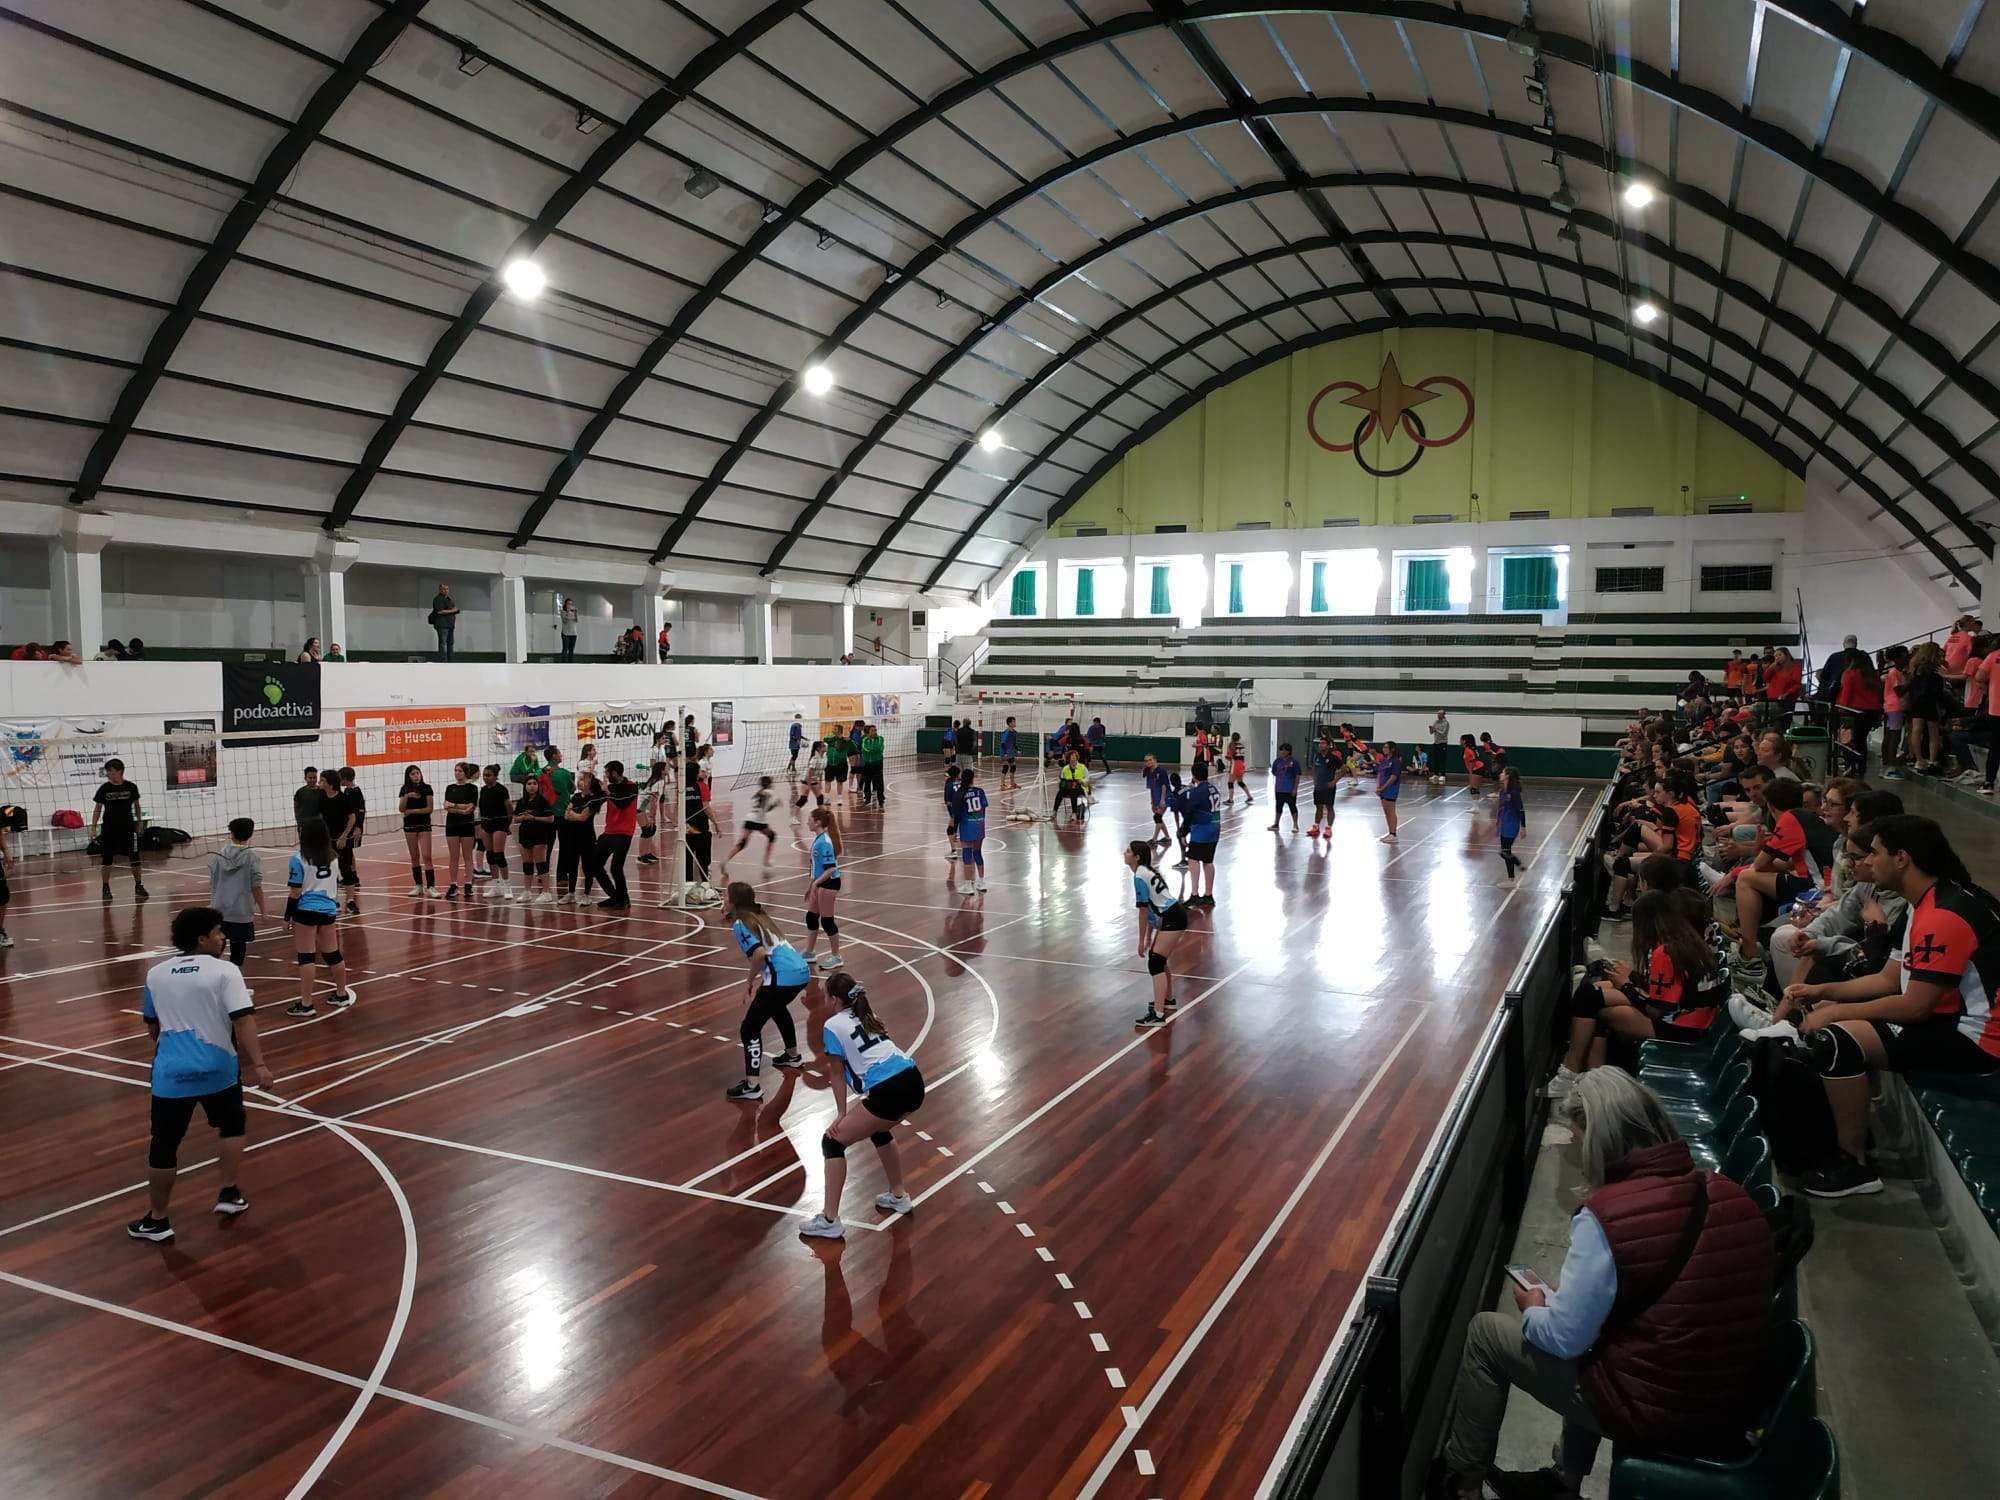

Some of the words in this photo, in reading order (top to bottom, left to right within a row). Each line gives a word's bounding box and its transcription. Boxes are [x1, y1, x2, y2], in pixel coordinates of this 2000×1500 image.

[234, 703, 313, 726] podoactiva
[390, 733, 402, 745] de
[404, 732, 442, 744] Huesca
[597, 726, 610, 740] DE
[966, 796, 982, 812] 10
[1208, 793, 1220, 812] 12
